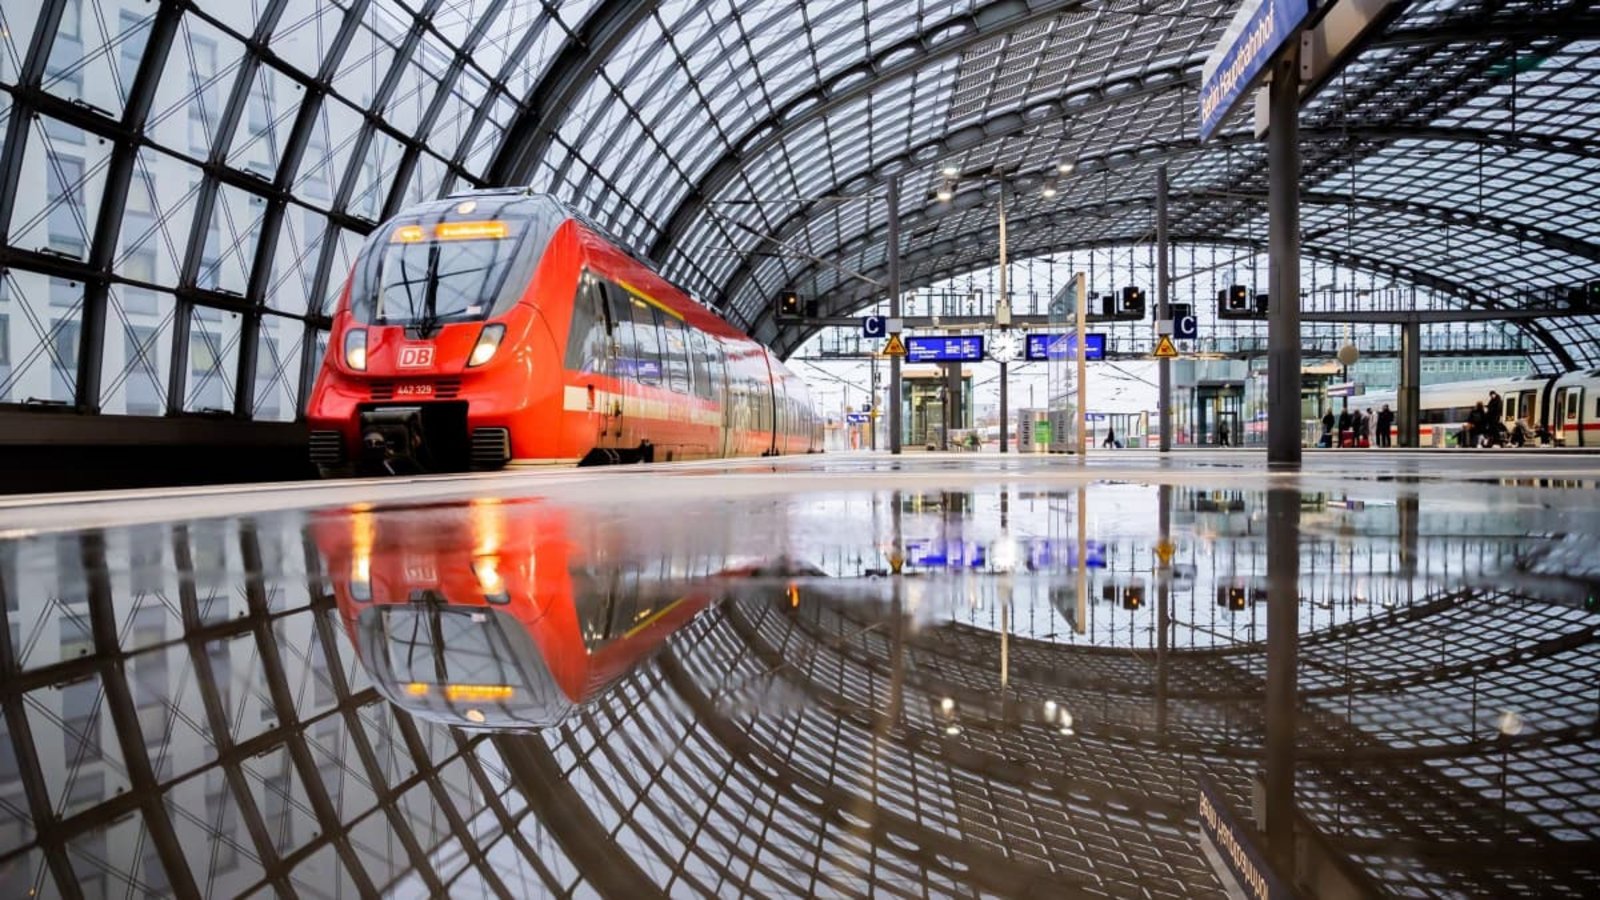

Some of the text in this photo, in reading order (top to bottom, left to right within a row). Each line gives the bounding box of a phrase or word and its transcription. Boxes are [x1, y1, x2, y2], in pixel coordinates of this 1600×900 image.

[1220, 1, 1274, 101] Hauptbahnhof
[865, 316, 879, 334] C
[1181, 316, 1195, 334] C
[401, 349, 431, 366] DB
